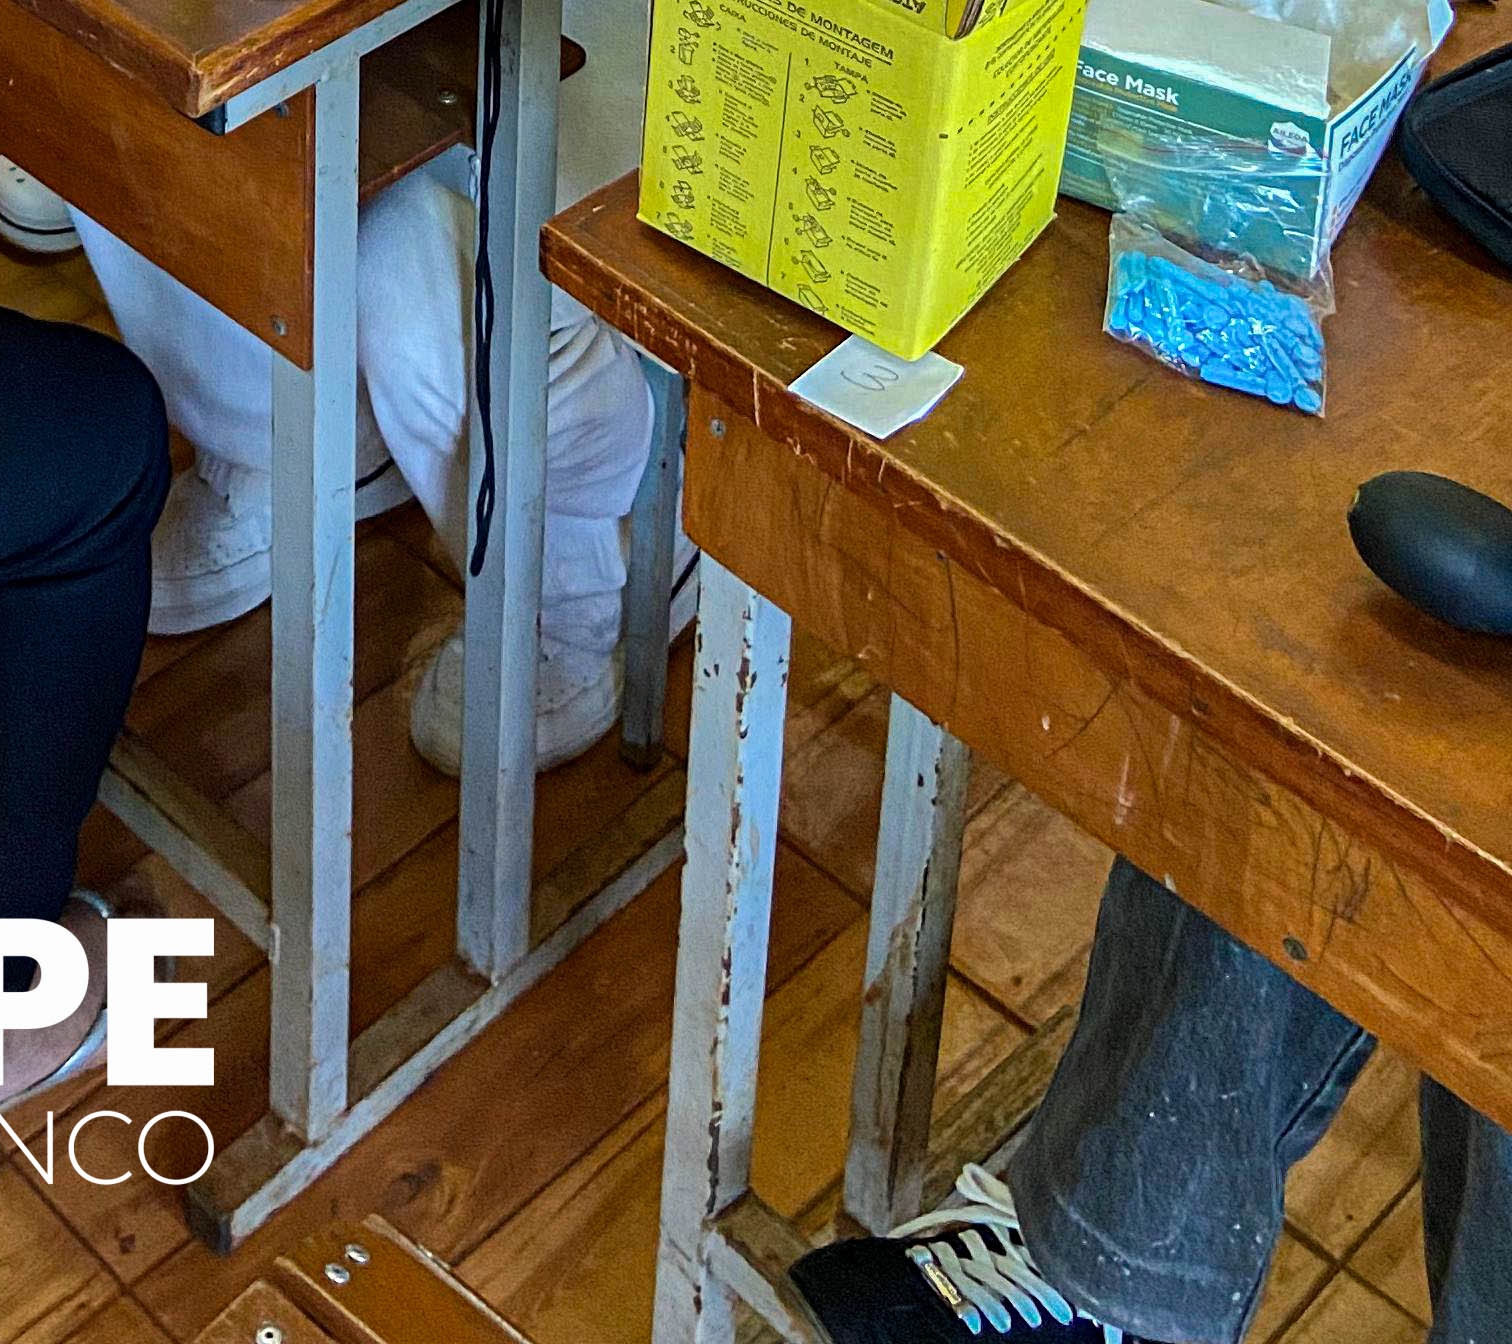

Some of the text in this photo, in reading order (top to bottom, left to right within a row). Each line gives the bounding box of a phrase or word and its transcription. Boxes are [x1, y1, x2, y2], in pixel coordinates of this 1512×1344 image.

[787, 0, 806, 19] DE
[810, 11, 894, 60] MONTAGEM
[801, 26, 816, 41] DE
[818, 35, 873, 69] MONTAJE
[1124, 73, 1180, 106] Mask
[1340, 104, 1379, 158] FACE
